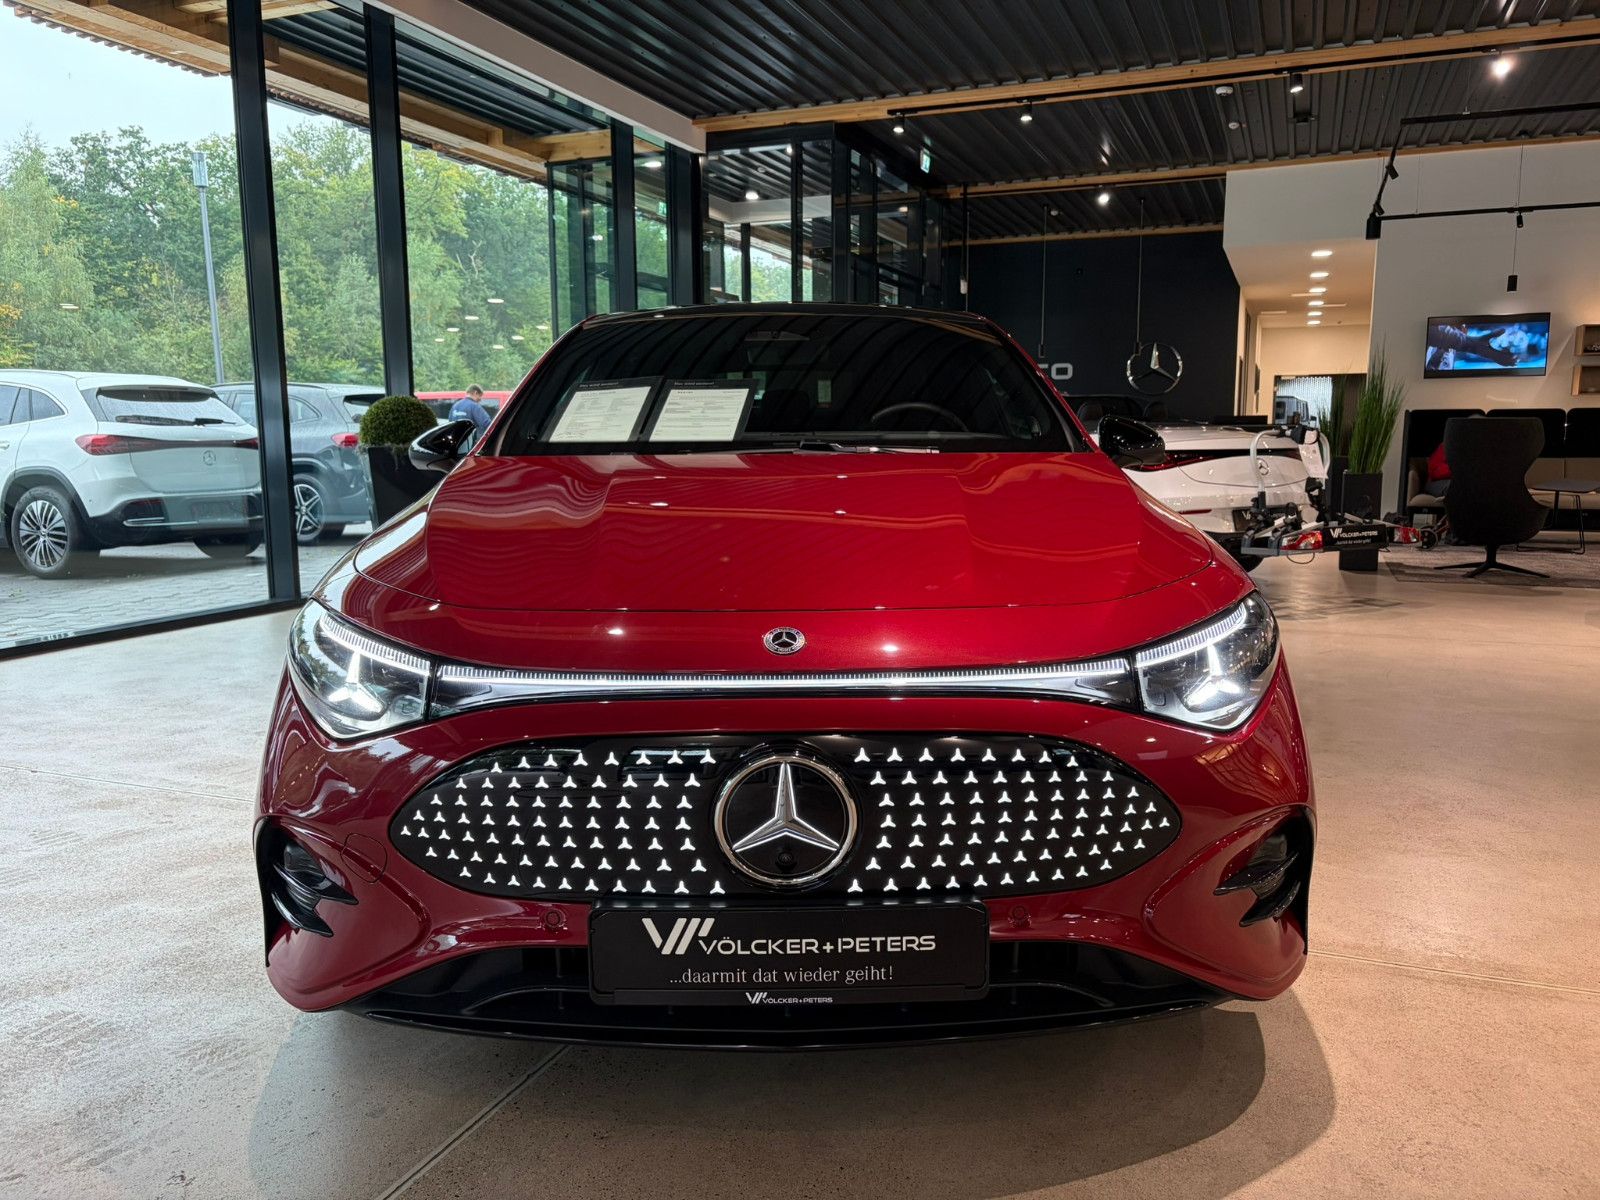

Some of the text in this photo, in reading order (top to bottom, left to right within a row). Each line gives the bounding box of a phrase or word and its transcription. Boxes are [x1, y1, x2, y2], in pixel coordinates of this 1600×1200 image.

[698, 935, 936, 955] VÖLCKER+PETERS
[670, 965, 893, 985] ...daarmit dat wieder geiht!
